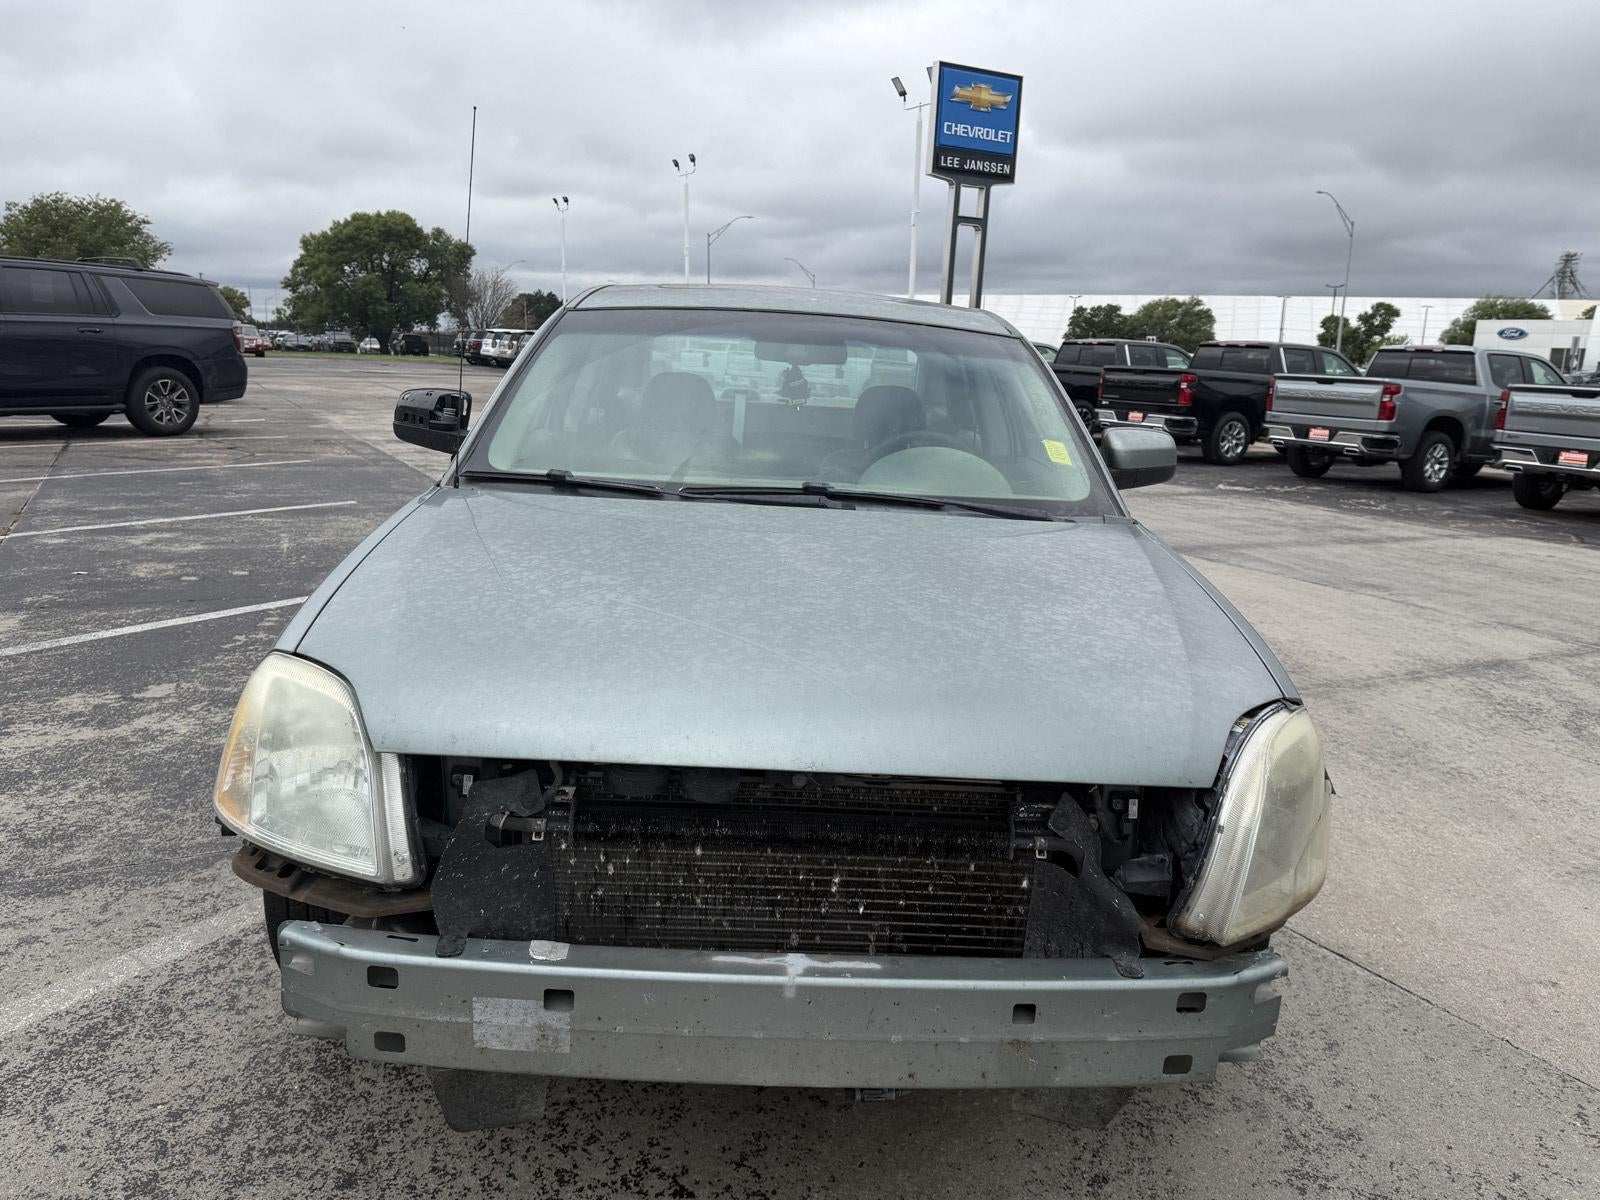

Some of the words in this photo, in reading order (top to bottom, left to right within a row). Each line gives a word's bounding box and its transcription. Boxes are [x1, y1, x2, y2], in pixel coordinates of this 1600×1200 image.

[943, 121, 1012, 144] CHEVROLET
[941, 155, 960, 168] LEE
[963, 159, 1011, 175] JANSSEN
